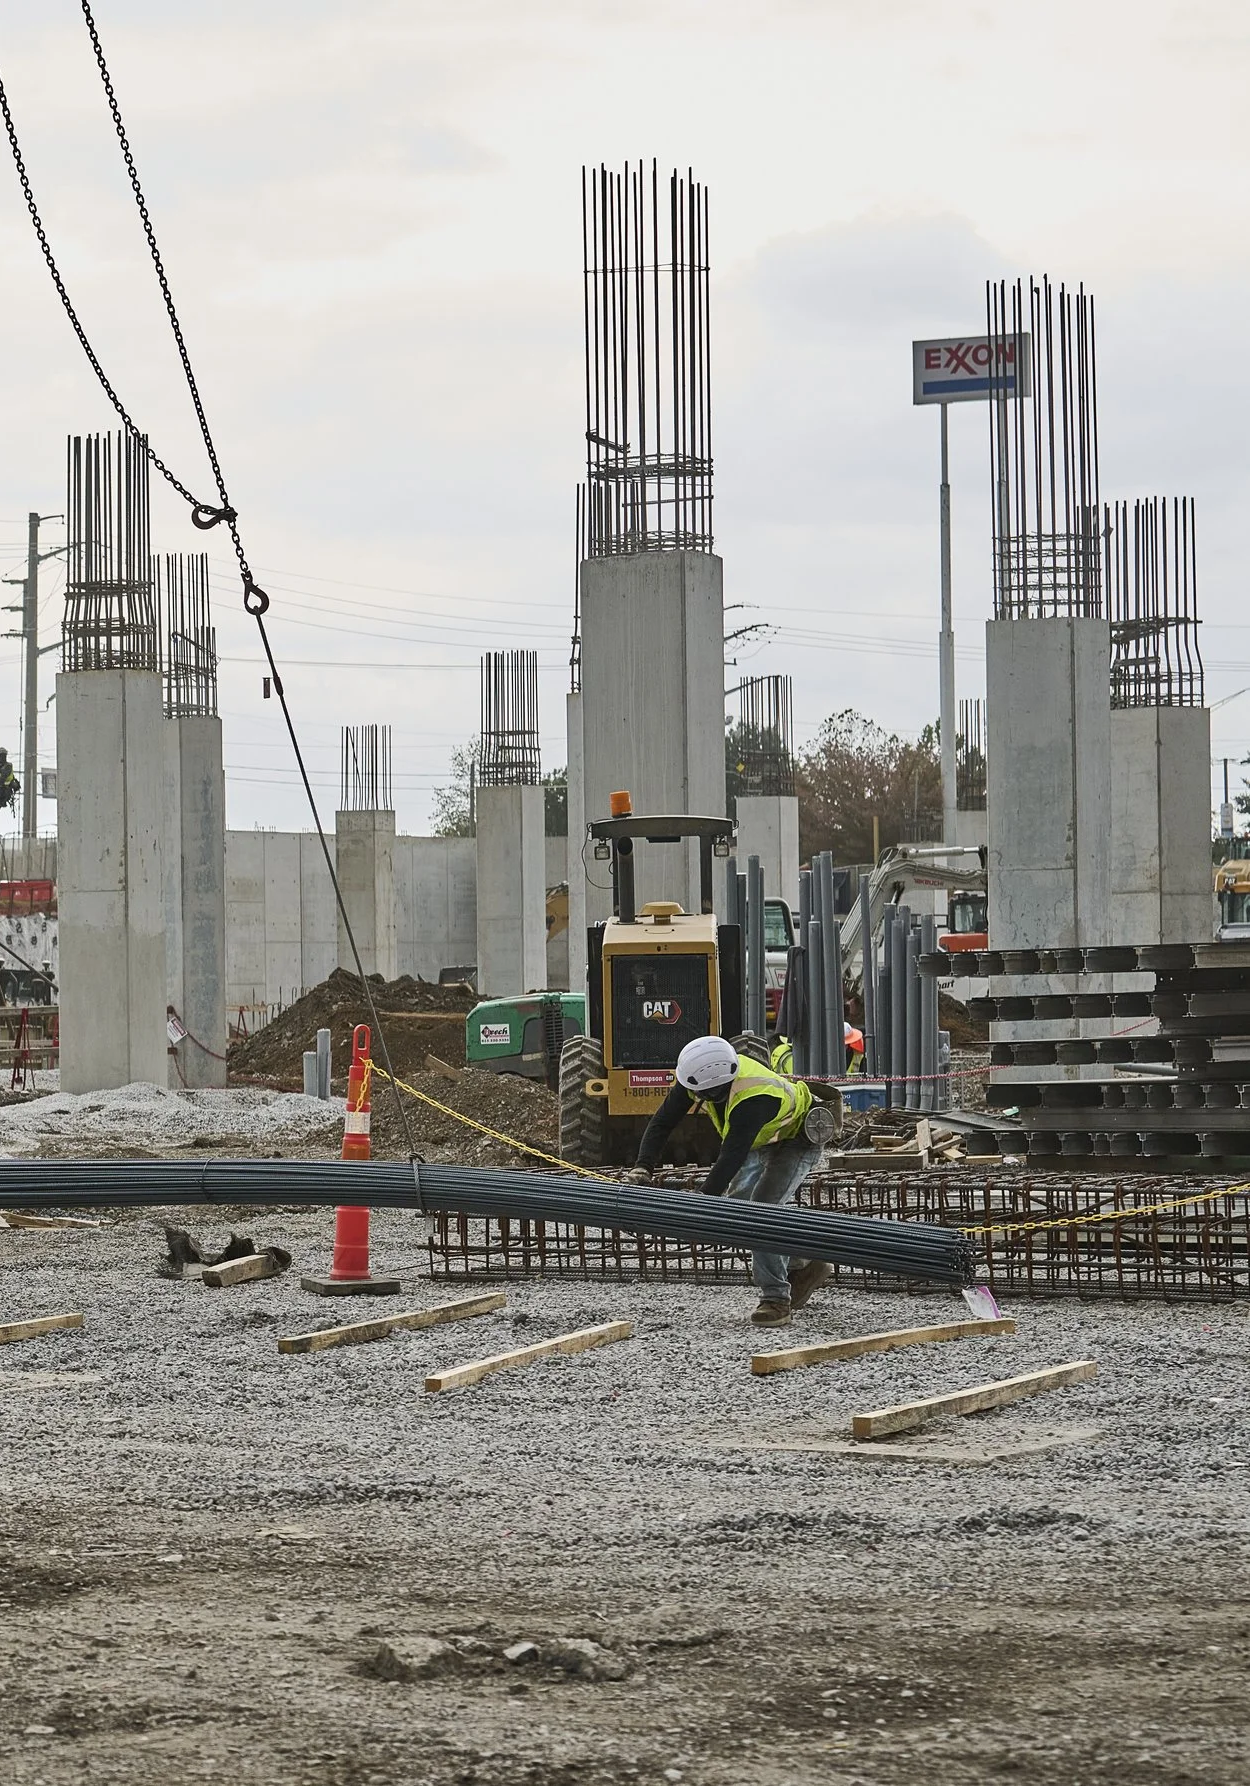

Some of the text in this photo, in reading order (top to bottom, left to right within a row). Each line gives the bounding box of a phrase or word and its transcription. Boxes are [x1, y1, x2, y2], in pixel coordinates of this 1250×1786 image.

[924, 342, 1016, 375] EXXON
[643, 1001, 671, 1018] CAT
[631, 1075, 663, 1083] Thompson
